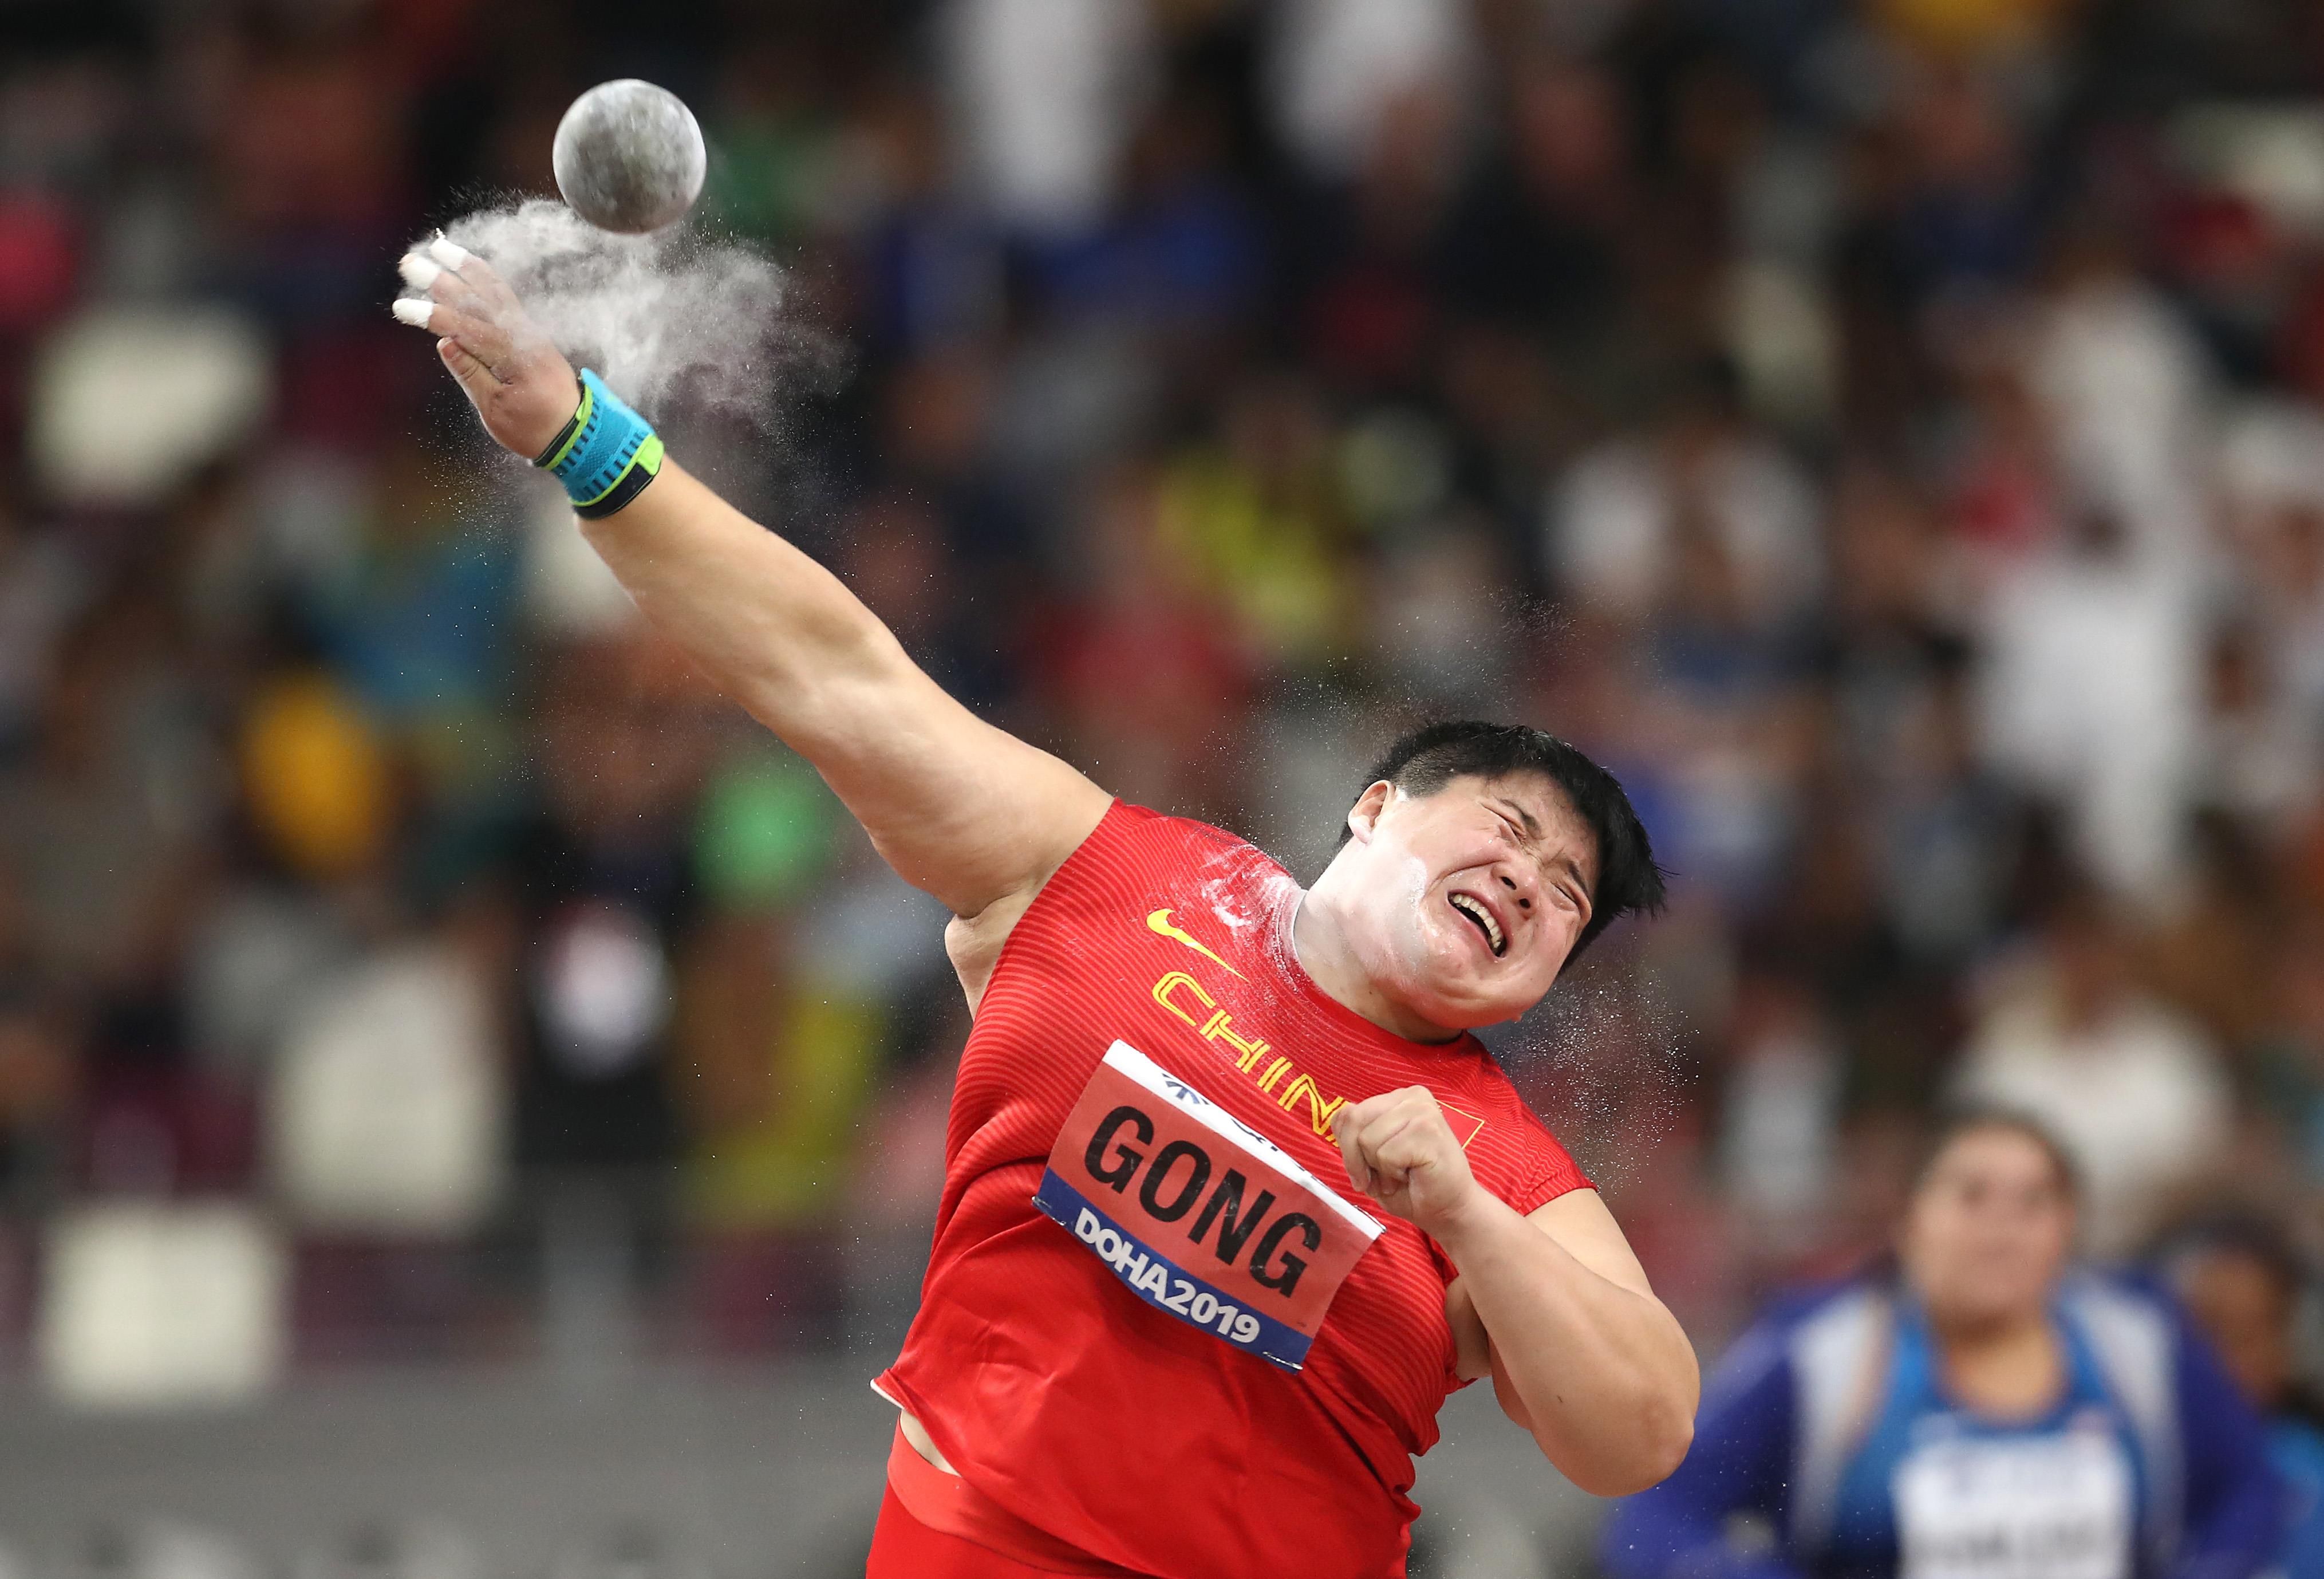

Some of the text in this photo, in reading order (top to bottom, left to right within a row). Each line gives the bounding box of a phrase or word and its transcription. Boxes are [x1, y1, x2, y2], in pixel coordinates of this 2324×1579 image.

[1151, 971, 1351, 1148] CHIN
[1074, 1207, 1260, 1344] DOHA2019
[1084, 1105, 1321, 1298] GONG
